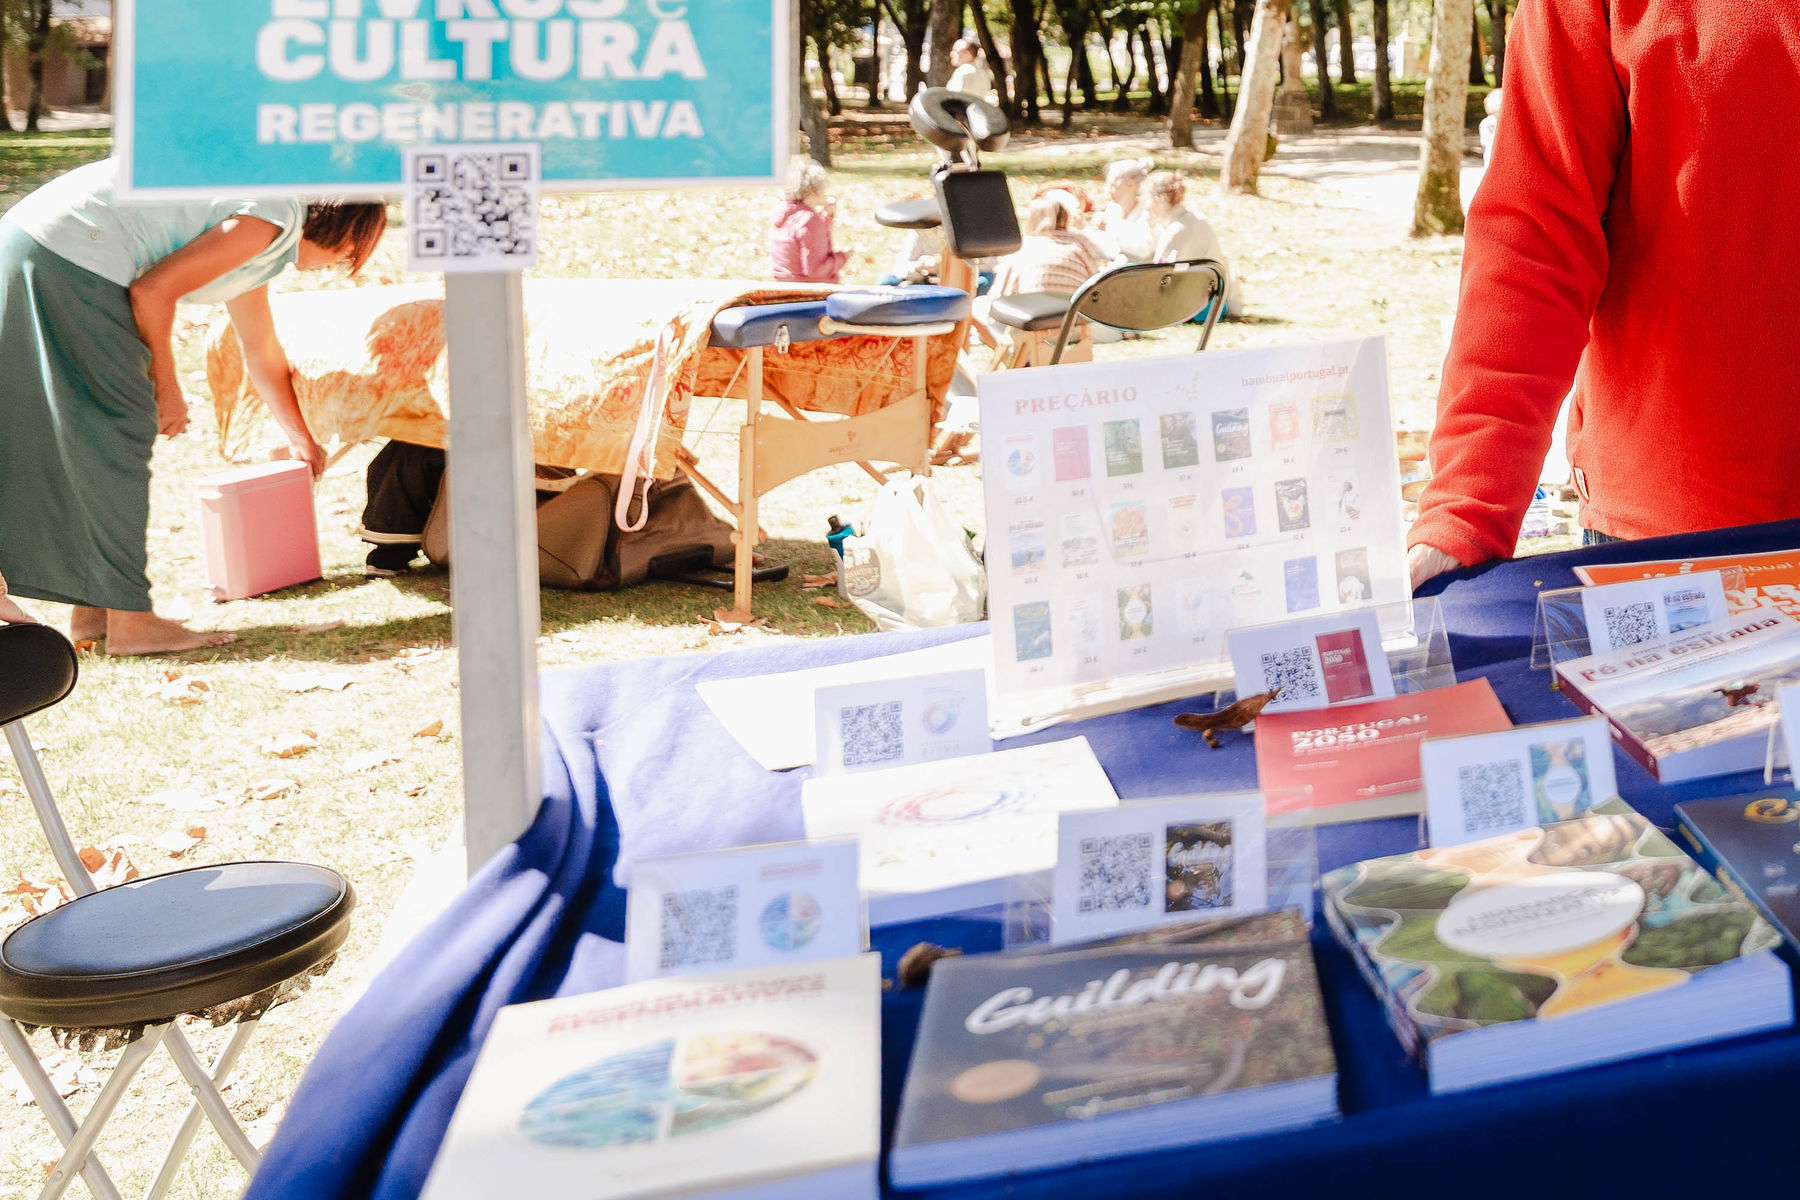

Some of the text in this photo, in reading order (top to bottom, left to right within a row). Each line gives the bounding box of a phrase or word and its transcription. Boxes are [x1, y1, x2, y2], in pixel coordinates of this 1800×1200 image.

[256, 19, 708, 81] CULTURA
[257, 101, 704, 144] REGENERATIVA
[1015, 386, 1138, 415] PREÇÁRIO
[1579, 663, 1618, 682] Pé
[1625, 650, 1664, 668] na
[1668, 617, 1782, 655] estrada
[1291, 713, 1428, 738] PORTUGAL
[1293, 727, 1380, 750] 2050
[965, 957, 1287, 1035] Guilding
